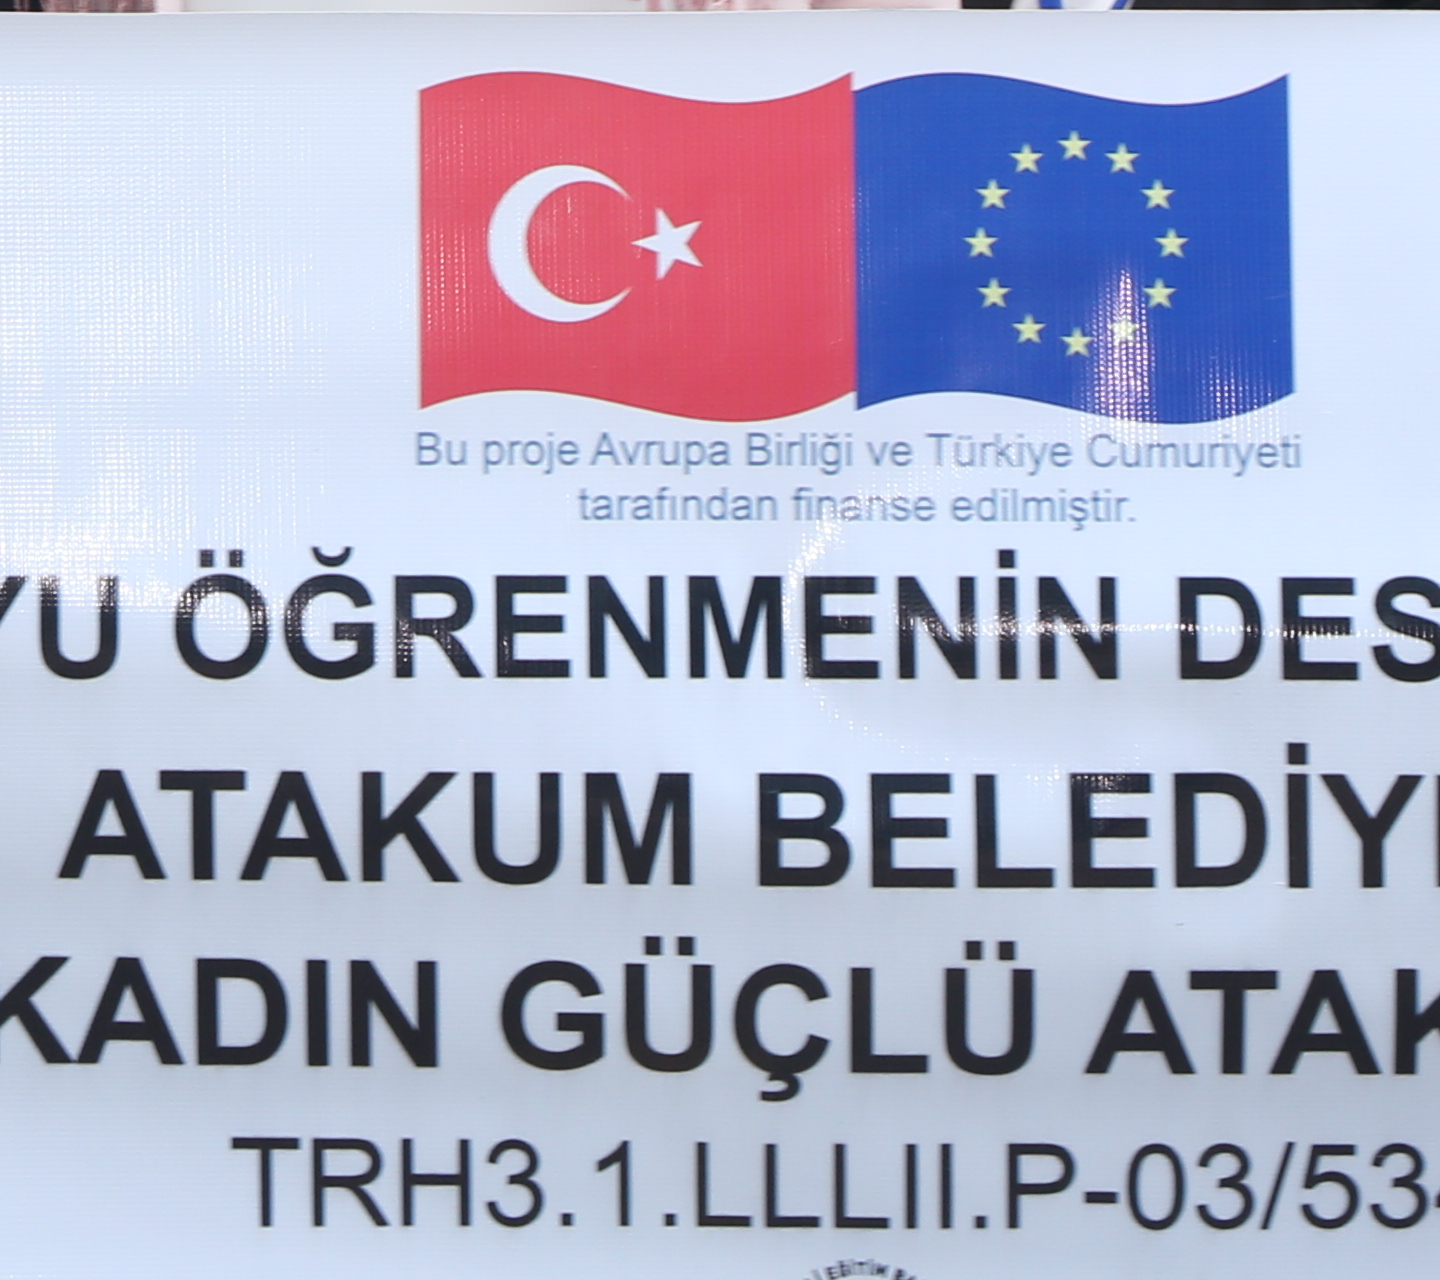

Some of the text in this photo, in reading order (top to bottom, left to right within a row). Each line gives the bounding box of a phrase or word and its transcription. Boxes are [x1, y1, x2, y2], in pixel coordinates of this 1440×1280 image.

[416, 431, 1302, 477] Bu proje Avrupa Birliği ve Türkiye Cumuriyeti
[578, 486, 1138, 532] tarafından finanse edilmiştir.
[173, 546, 1120, 684] ÖĞRENMENİN
[57, 768, 694, 887] ATAKUM
[499, 934, 1035, 1103] GÜÇLÜ
